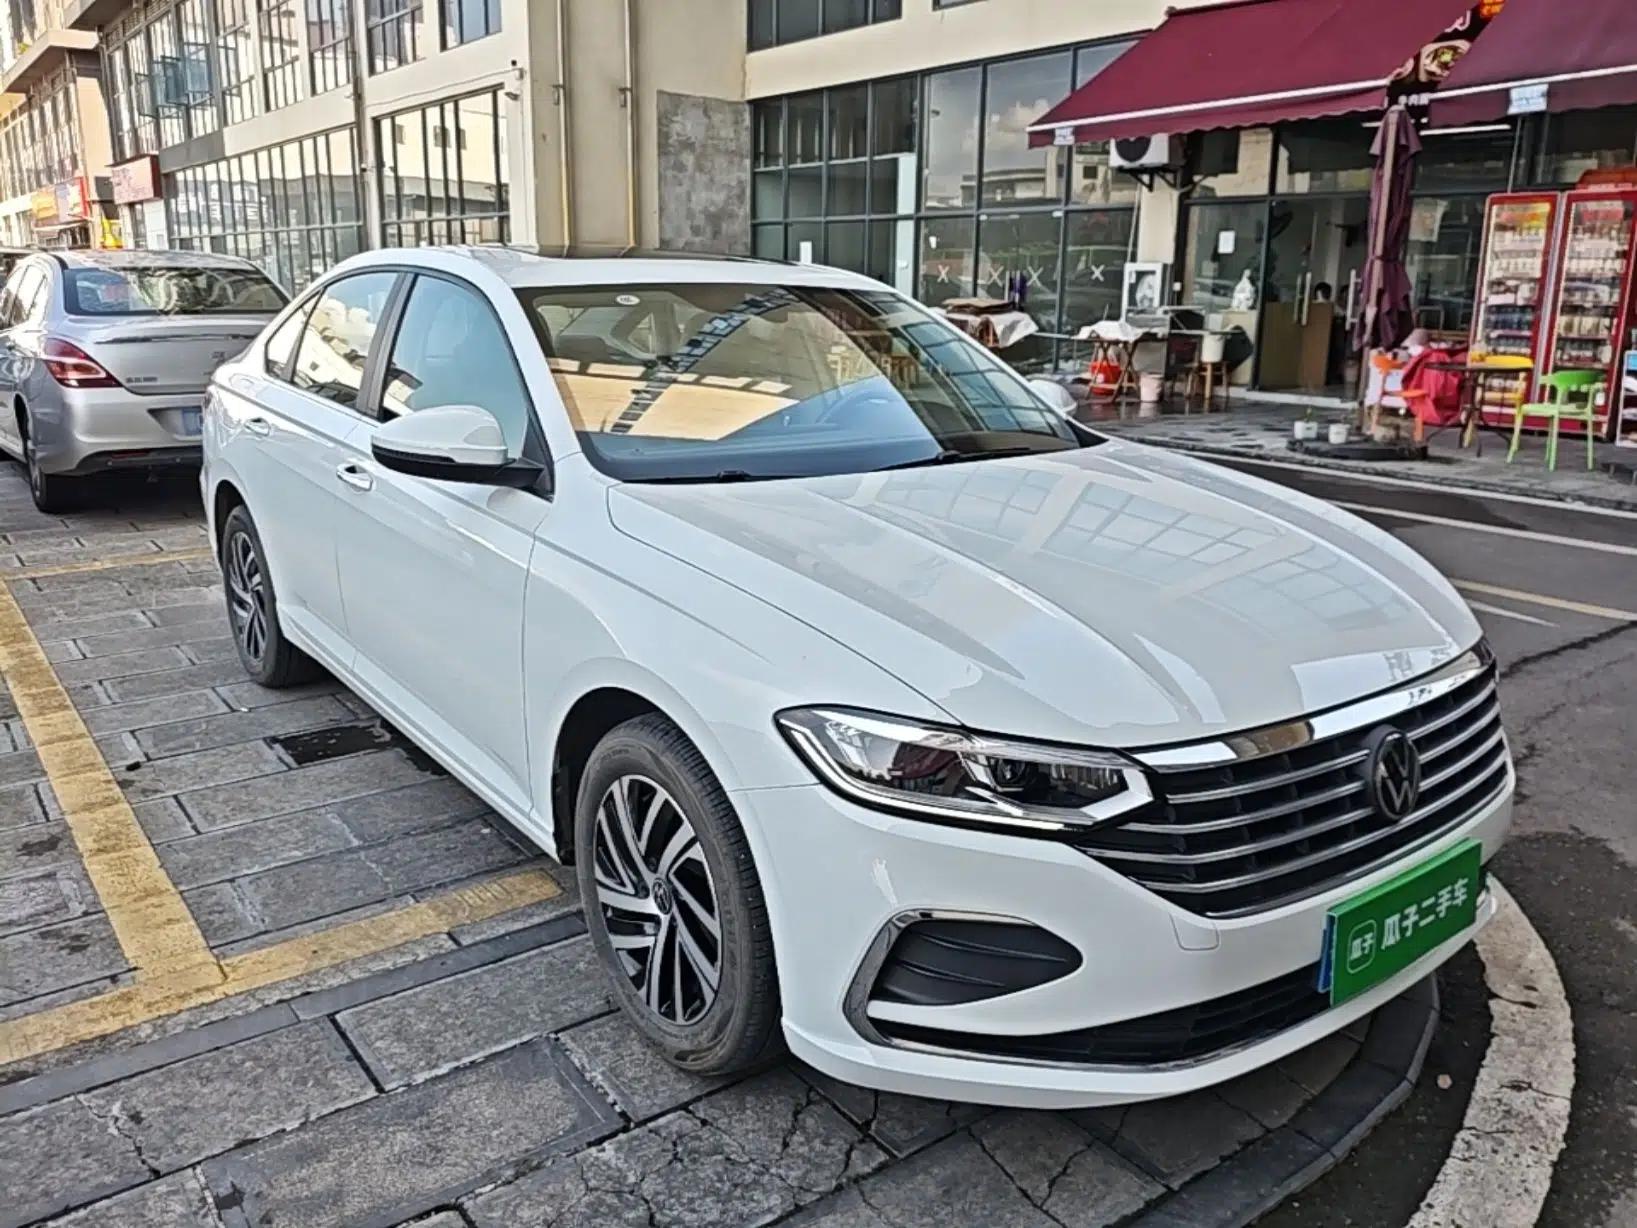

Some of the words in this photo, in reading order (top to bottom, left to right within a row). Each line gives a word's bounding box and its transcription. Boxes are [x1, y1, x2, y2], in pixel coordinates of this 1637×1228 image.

[1381, 877, 1469, 951] 瓜子二手车
[1350, 931, 1375, 961] 瓜子
